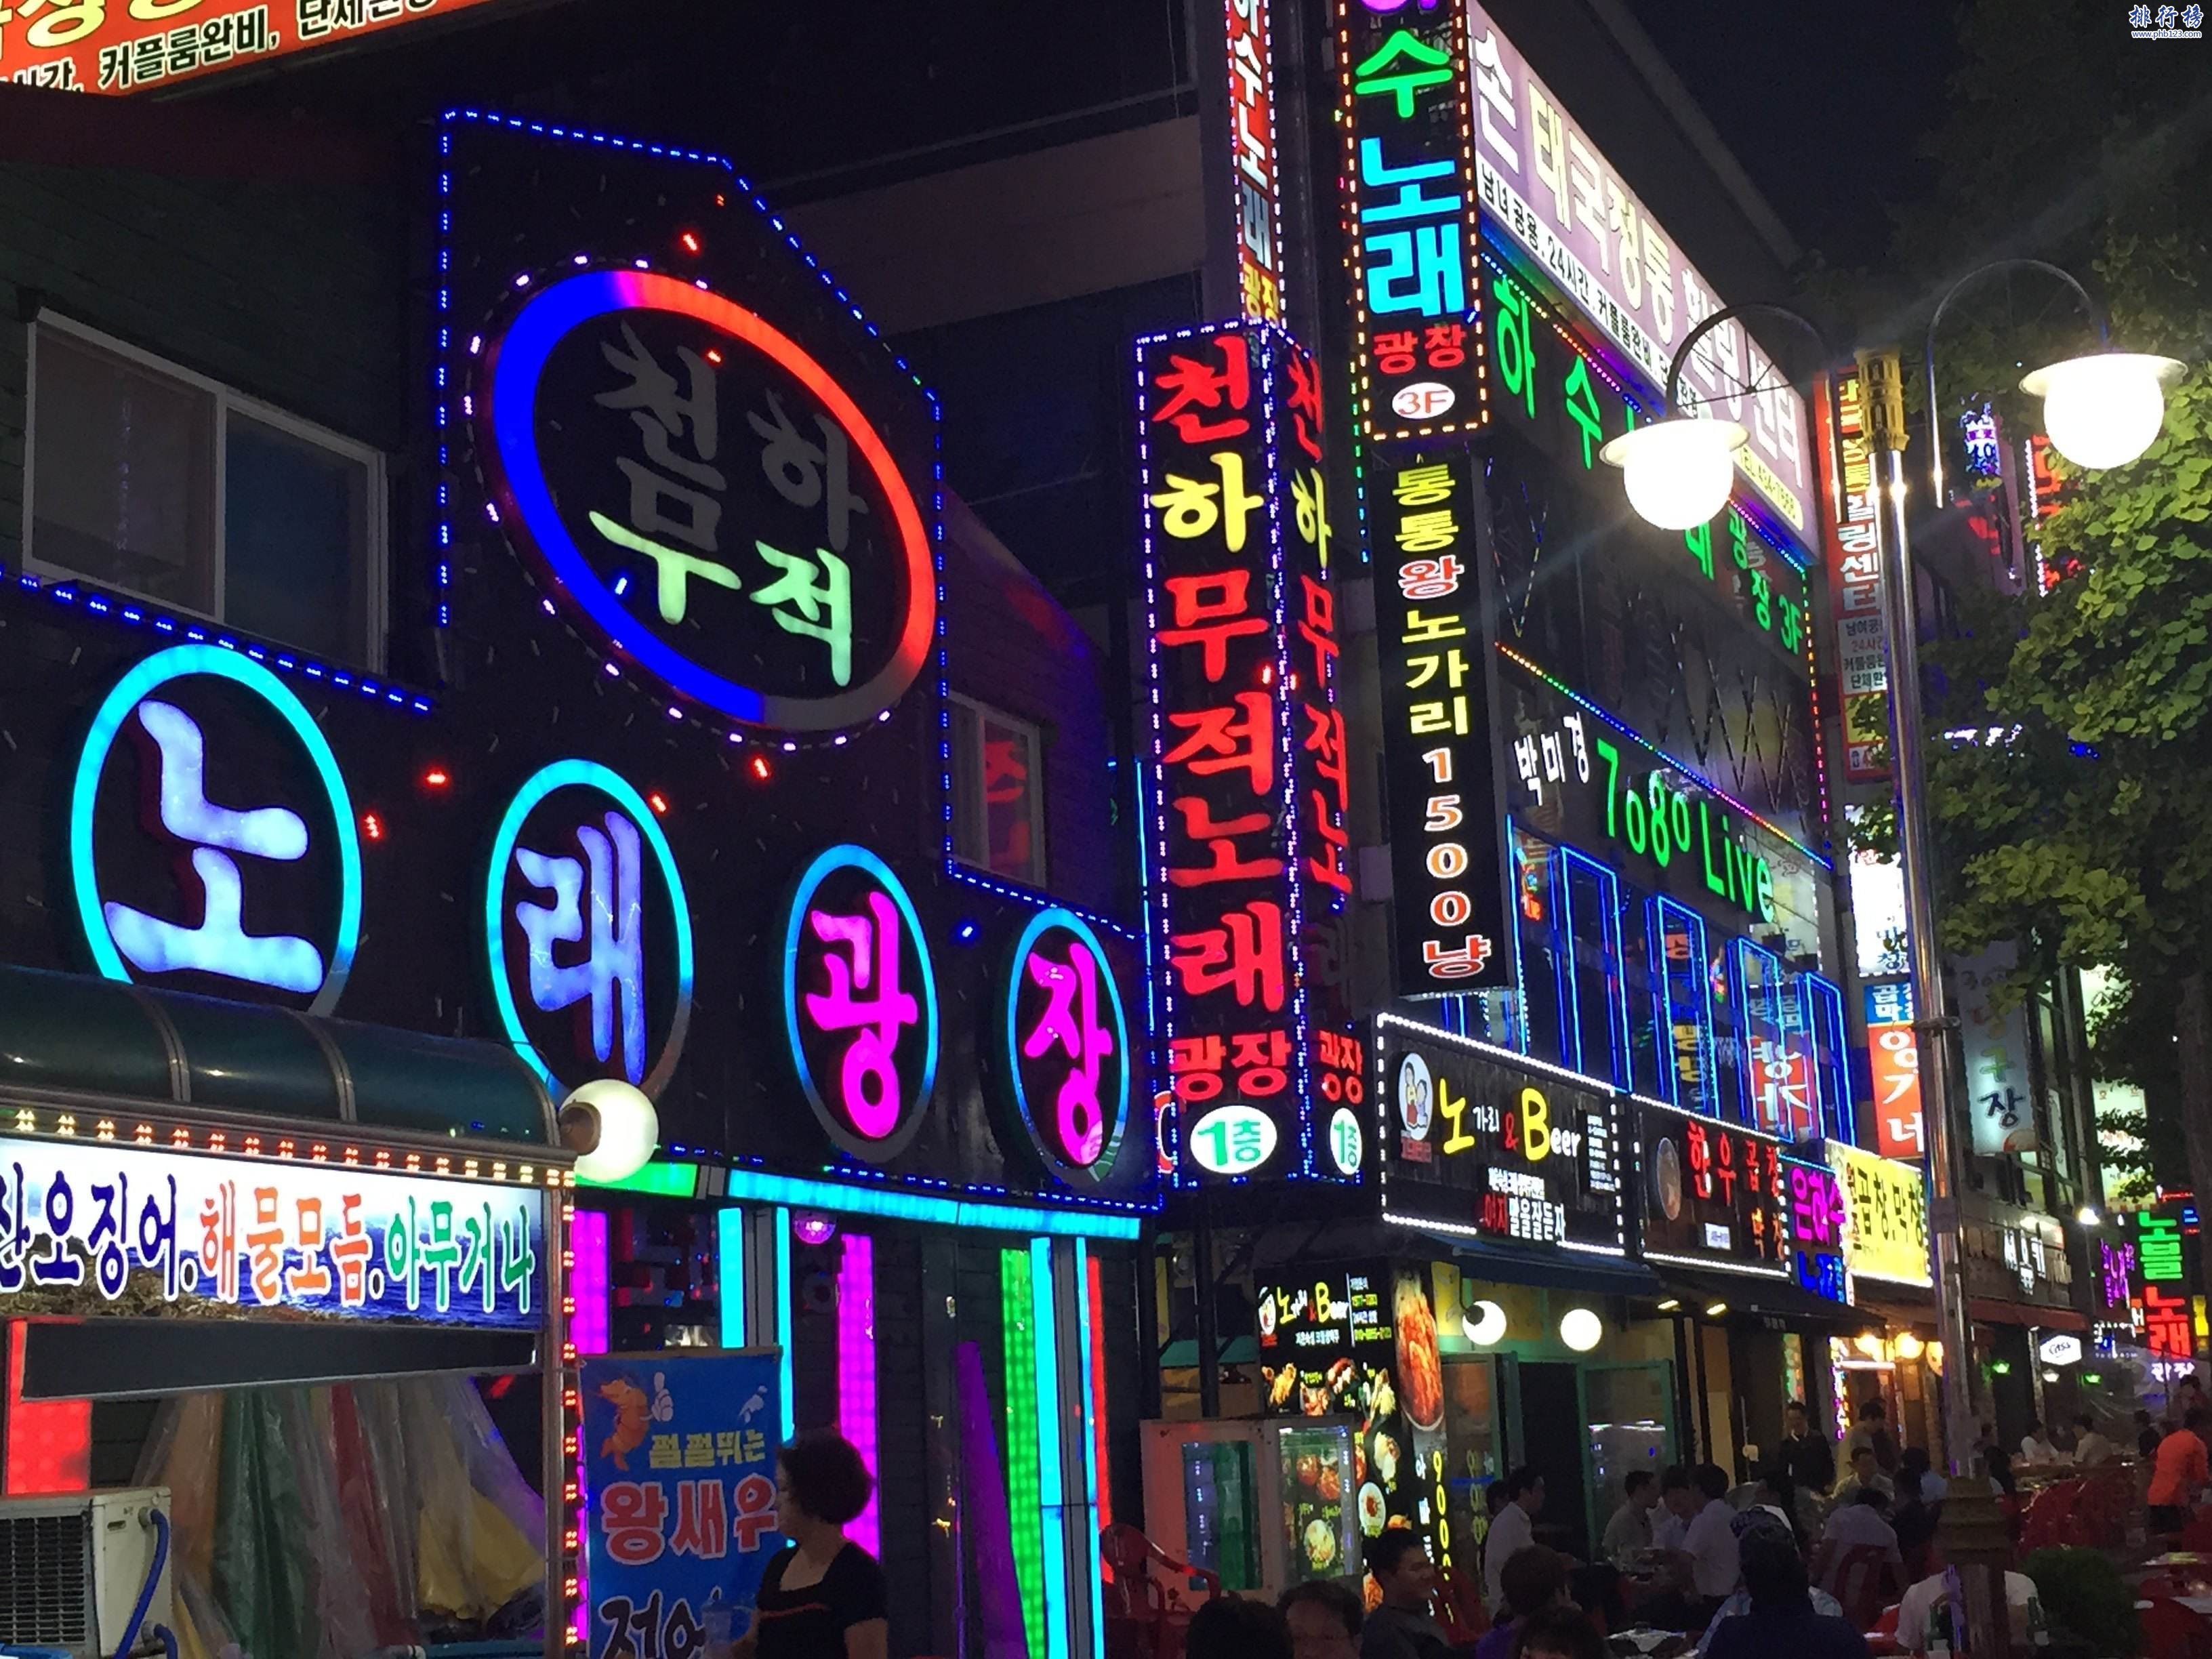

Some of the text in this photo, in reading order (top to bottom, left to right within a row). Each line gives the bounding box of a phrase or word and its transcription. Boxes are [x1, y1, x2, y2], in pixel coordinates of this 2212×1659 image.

[1373, 325, 1466, 374] 광장
[1398, 389, 1448, 417] 3F
[1514, 712, 1775, 924] 박미경 7080 Live
[1168, 1030, 1292, 1103] 광장
[1318, 1029, 1364, 1104] 광장
[1196, 1120, 1261, 1167] 1층
[1521, 1087, 1582, 1162] Beer
[384, 1193, 535, 1315] 아무거나
[600, 1473, 779, 1565] 왕새우
